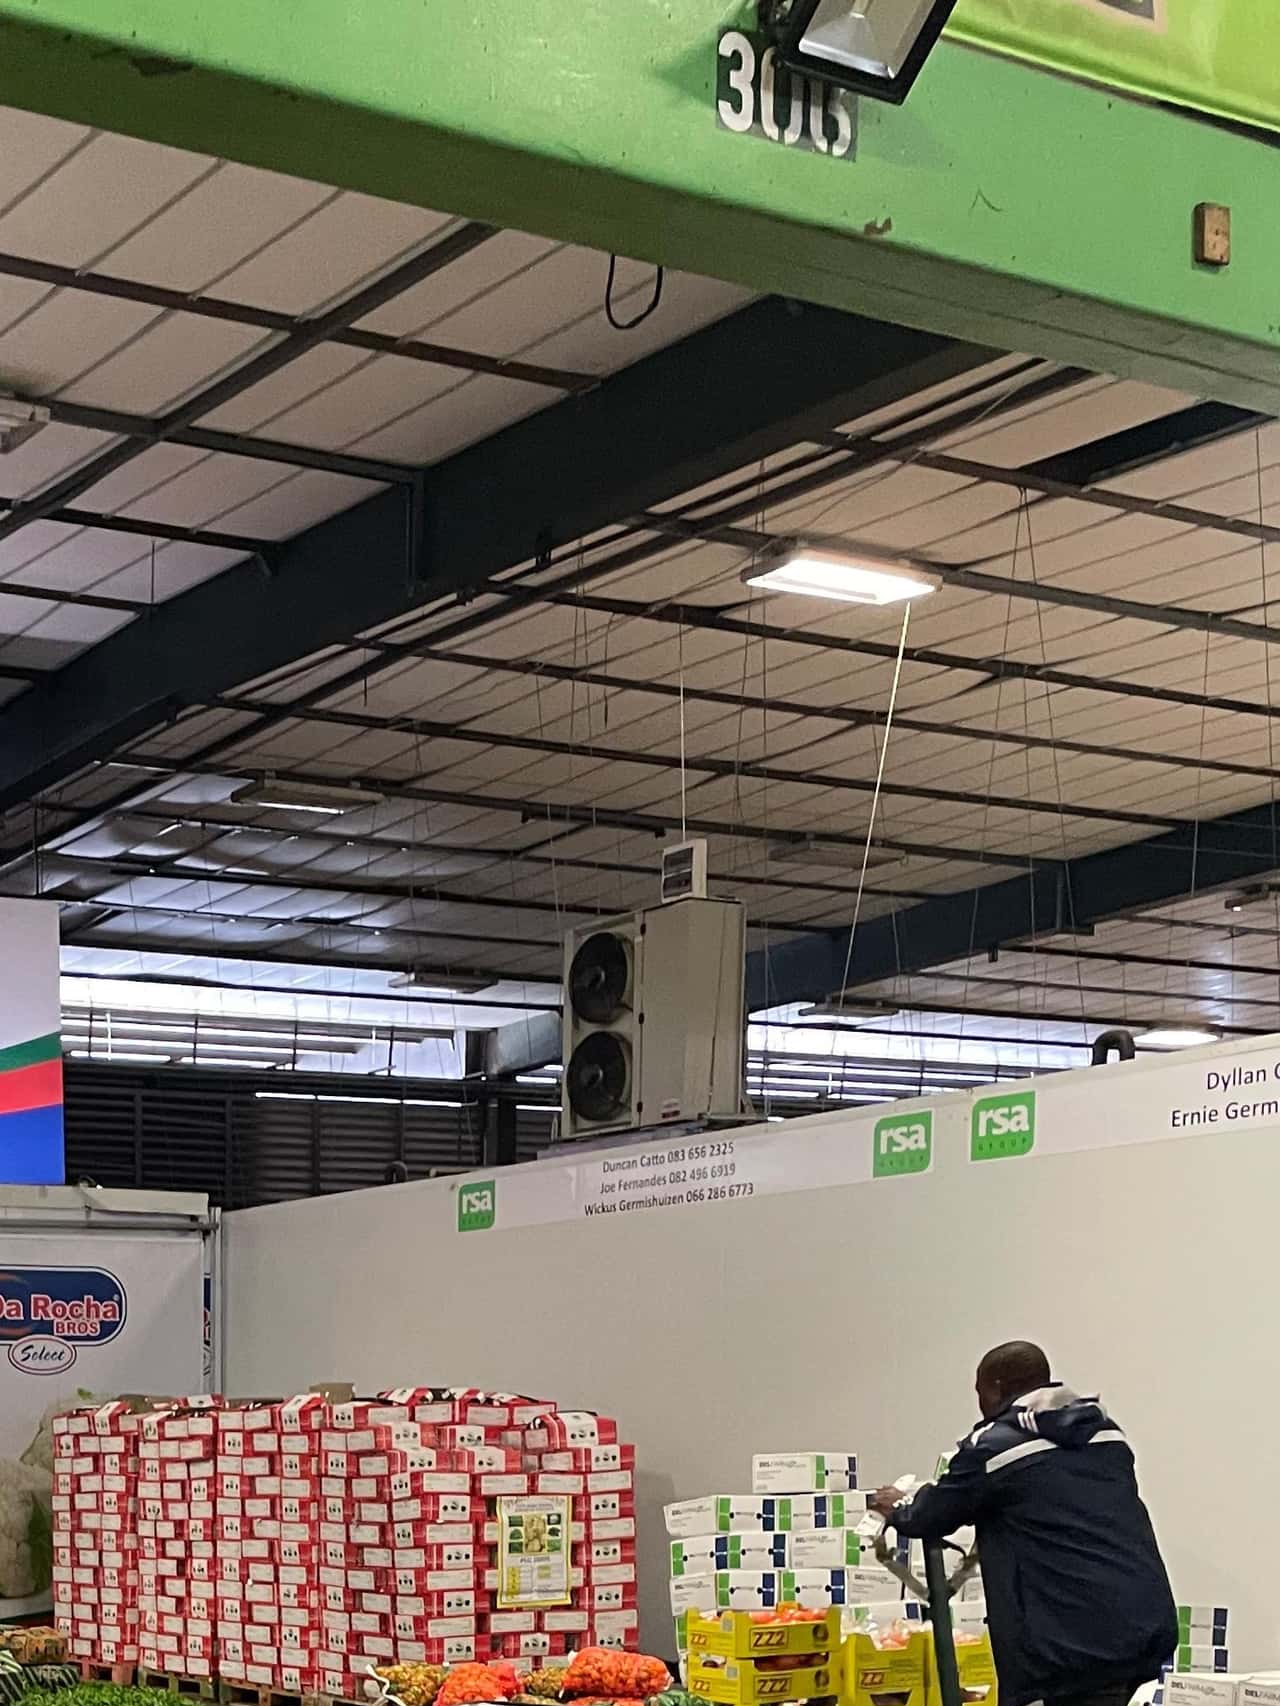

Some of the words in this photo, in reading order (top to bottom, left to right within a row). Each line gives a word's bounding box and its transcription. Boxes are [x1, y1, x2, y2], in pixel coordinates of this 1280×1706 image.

[1207, 1066, 1266, 1092] Dyllan
[978, 1104, 1029, 1137] rsa
[1172, 1105, 1218, 1127] Ernie
[880, 1124, 927, 1154] rsa
[603, 1160, 637, 1173] Duncan
[640, 1154, 665, 1169] Catto
[667, 1149, 685, 1164] 083
[688, 1146, 706, 1160] 656
[709, 1142, 734, 1157] 2325
[600, 1182, 616, 1194] Joe
[618, 1174, 666, 1192] Fernandes
[669, 1170, 687, 1184] 082
[690, 1167, 708, 1181] 496
[462, 1191, 492, 1214] rsa
[584, 1202, 617, 1216] Wickus
[619, 1192, 684, 1213] Germishuizen
[686, 1190, 705, 1203] 066
[707, 1186, 726, 1201] 286
[728, 1183, 753, 1198] 6773
[31, 1294, 119, 1321] Rocha
[54, 1320, 100, 1336] BROS
[20, 1345, 65, 1362] Select
[751, 1630, 786, 1647] ZZ2
[757, 1677, 789, 1695] ZZ2
